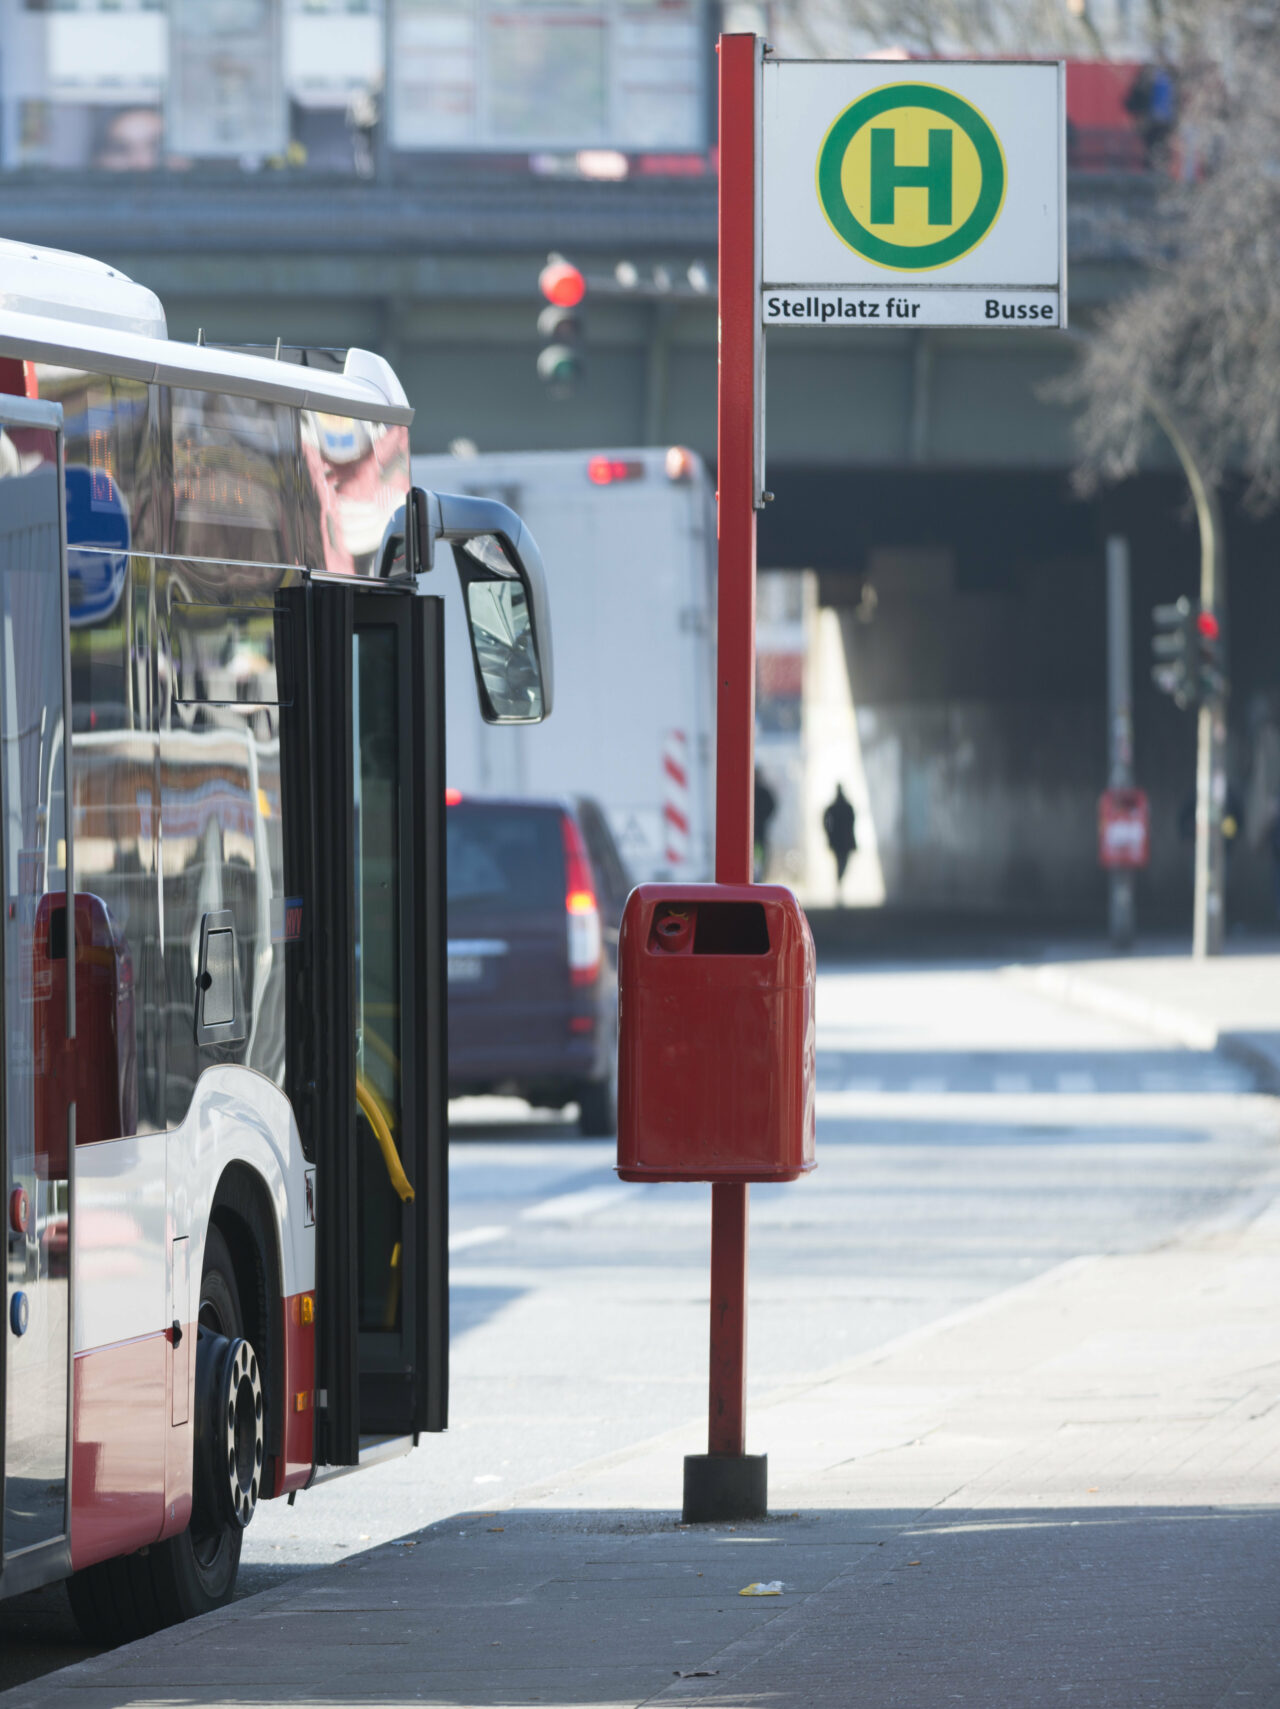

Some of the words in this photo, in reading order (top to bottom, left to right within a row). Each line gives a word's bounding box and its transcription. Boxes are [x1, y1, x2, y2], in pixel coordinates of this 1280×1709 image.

[870, 128, 952, 225] H
[767, 297, 880, 322] Stellplatz
[886, 298, 921, 318] für
[984, 300, 1054, 319] Busse
